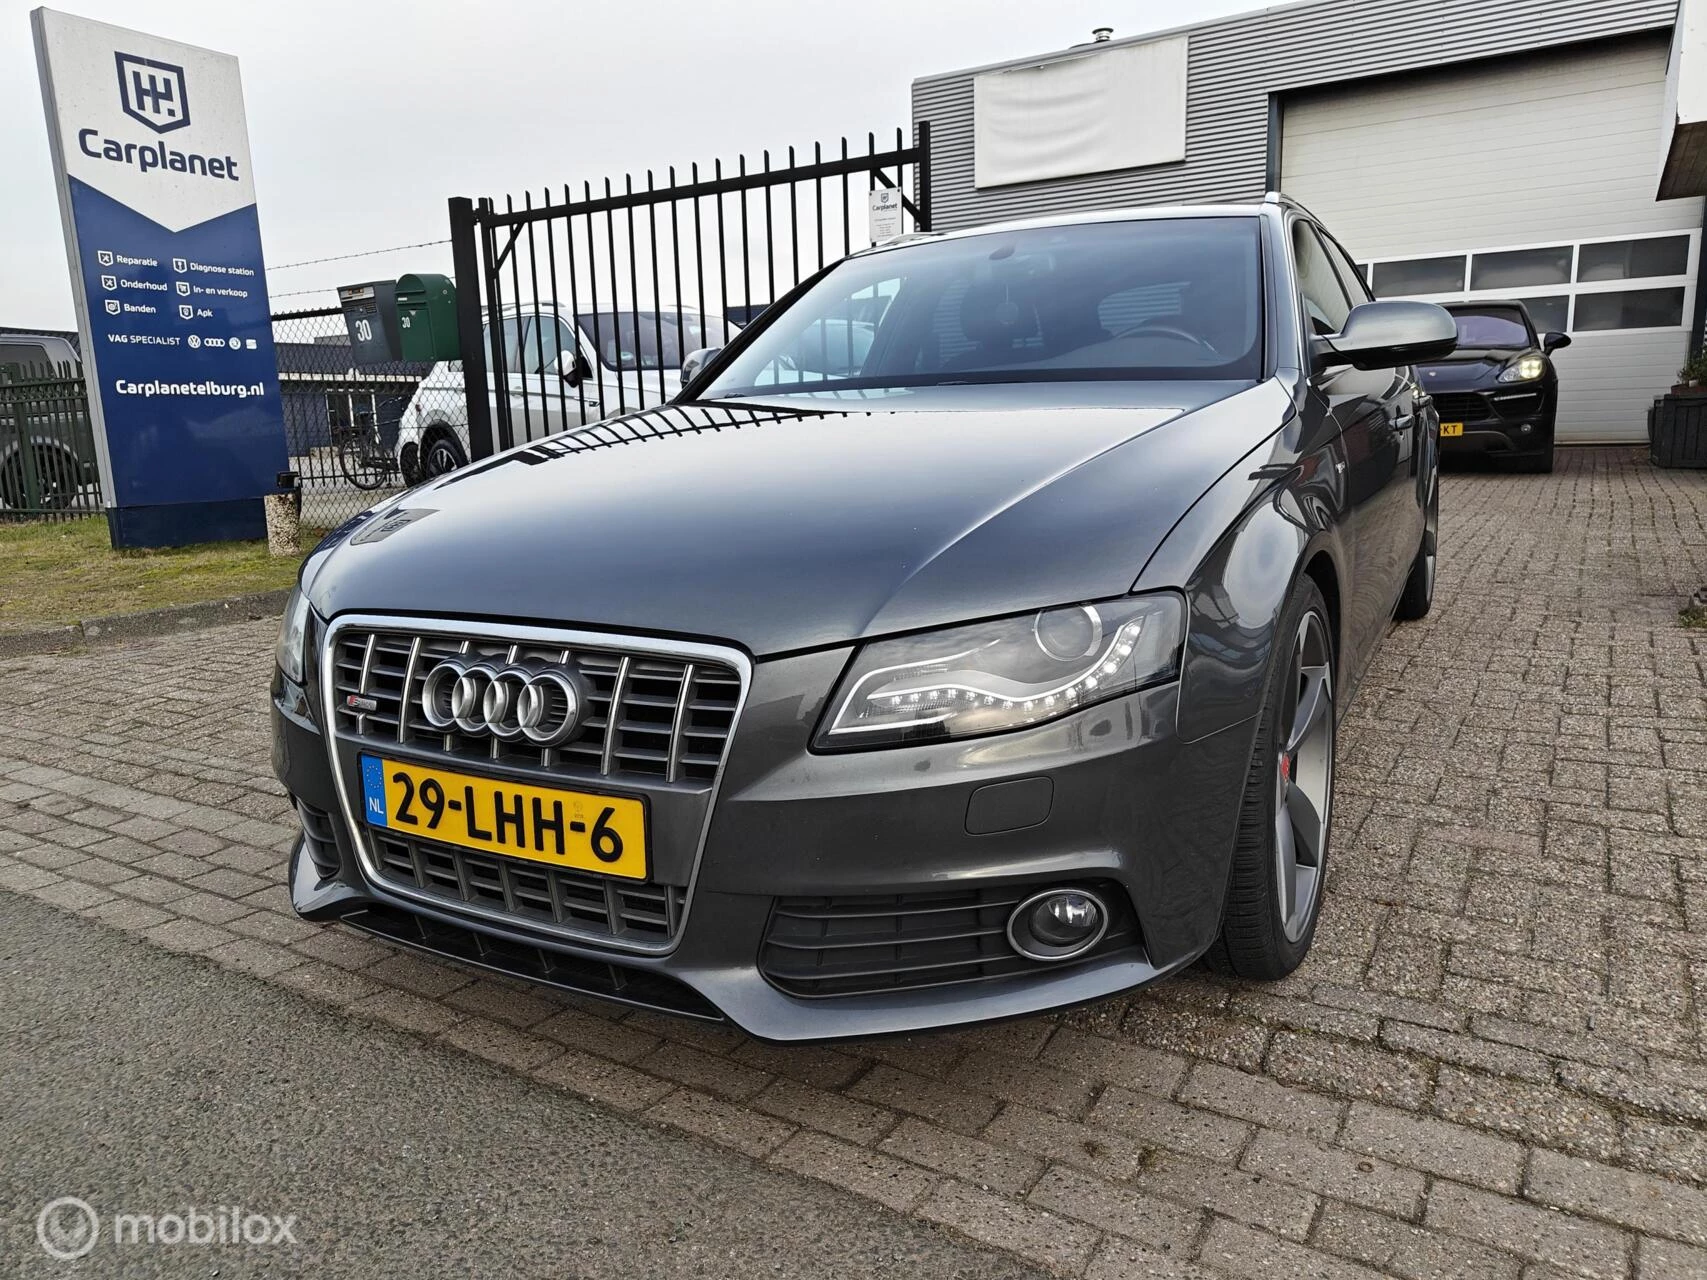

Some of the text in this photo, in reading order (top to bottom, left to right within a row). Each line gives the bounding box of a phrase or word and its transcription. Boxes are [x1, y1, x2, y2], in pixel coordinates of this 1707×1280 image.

[78, 128, 240, 182] Carplanet
[117, 255, 158, 266] Reparatie
[190, 263, 254, 276] Diagnose station
[120, 280, 168, 291] Onderhoud
[193, 286, 248, 298] In- en verkoop
[124, 303, 156, 314] Banden
[196, 308, 213, 318] Apk
[402, 317, 410, 328] 30
[355, 319, 372, 341] 30
[108, 333, 180, 346] VAG SPECIALIST
[115, 379, 265, 398] Carplanetelburg.nl
[369, 797, 384, 815] NL
[392, 771, 624, 863] 29-LHH-6
